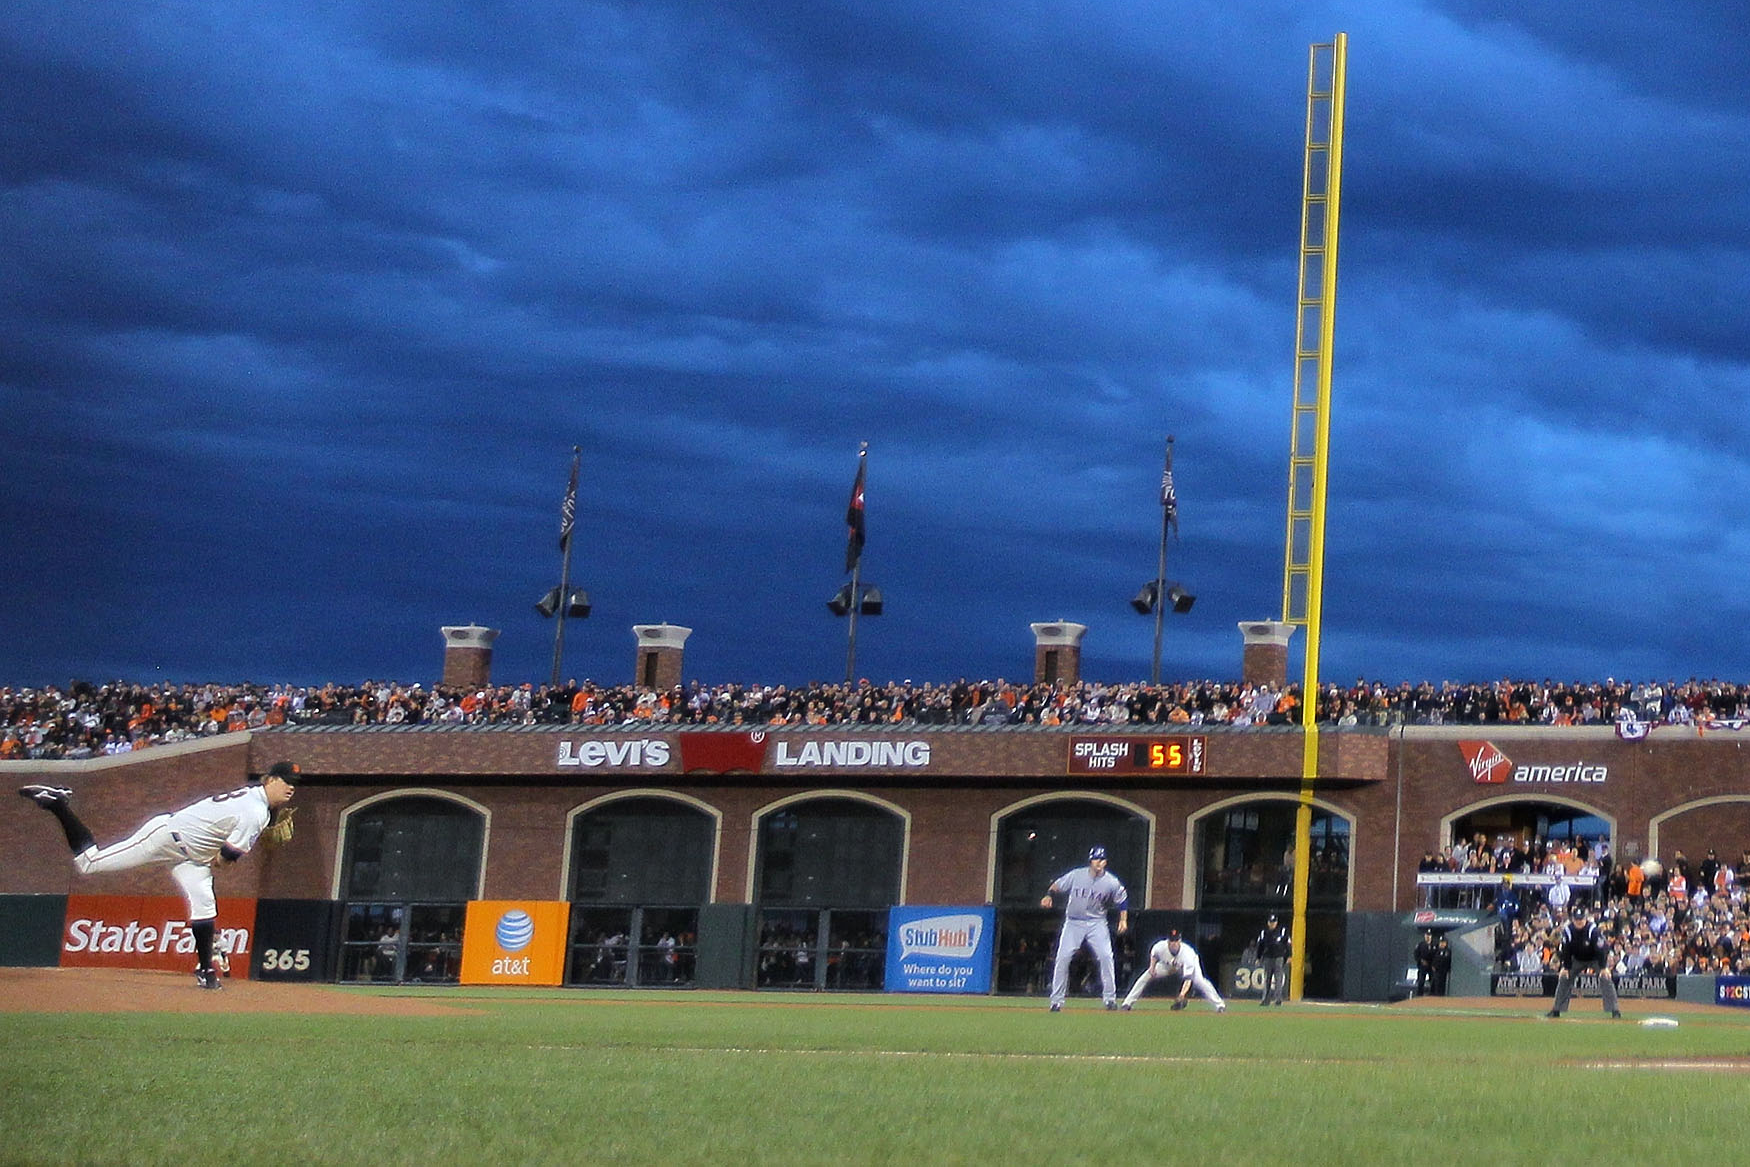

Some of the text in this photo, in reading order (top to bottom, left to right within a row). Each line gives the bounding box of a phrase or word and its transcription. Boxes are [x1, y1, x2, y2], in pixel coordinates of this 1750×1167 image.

[776, 741, 931, 767] LANDING
[1075, 742, 1129, 756] SPLASH
[1151, 744, 1183, 766] 55
[1088, 756, 1115, 768] HITS
[1469, 746, 1504, 781] Virgin
[1514, 760, 1608, 783] america
[158, 921, 249, 954] Fam
[905, 923, 976, 947] StubHub!
[263, 949, 311, 971] 365
[491, 956, 531, 975] at&t
[903, 964, 973, 977] Where do you
[908, 977, 967, 988] want to sit?
